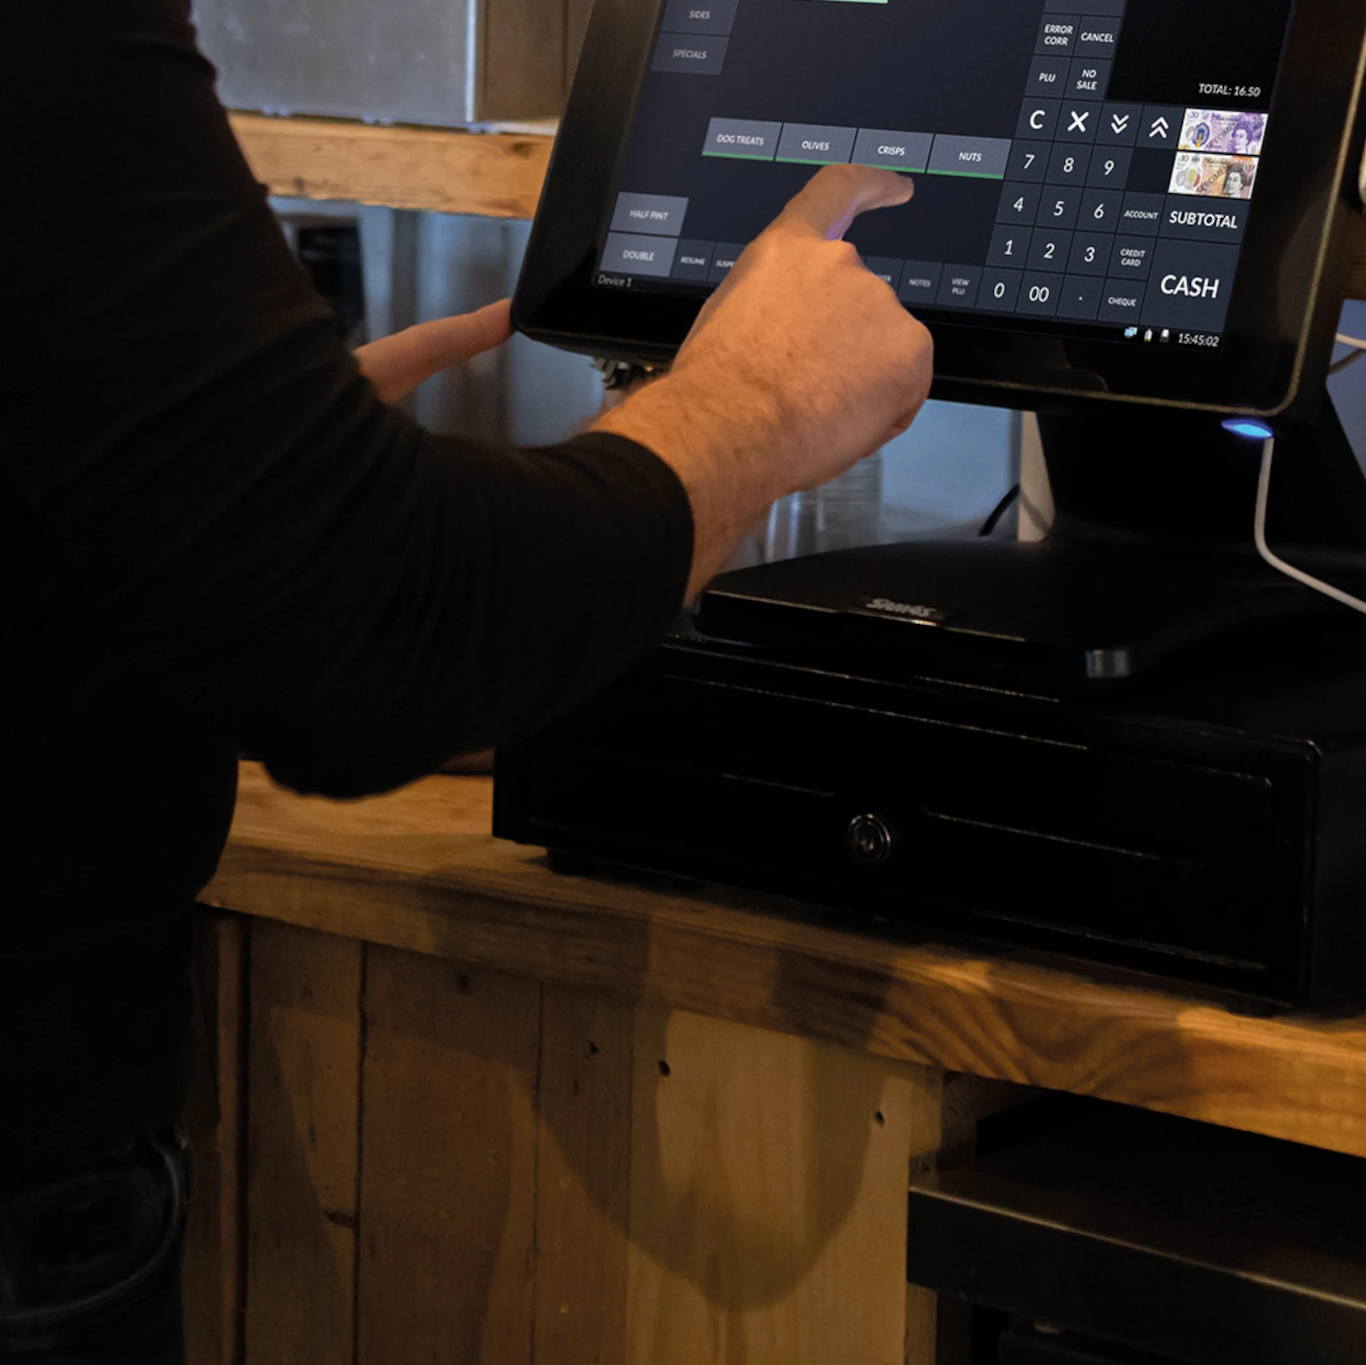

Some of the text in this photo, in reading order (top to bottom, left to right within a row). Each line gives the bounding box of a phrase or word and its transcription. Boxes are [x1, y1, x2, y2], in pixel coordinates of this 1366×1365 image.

[689, 10, 711, 19] SIDES
[1044, 24, 1074, 34] ERROR
[1044, 36, 1069, 46] CORR
[1080, 32, 1114, 43] CANCEL
[672, 48, 708, 60] SPECIALS
[1038, 72, 1056, 82] PLU
[1082, 69, 1097, 78] NO
[1076, 80, 1098, 90] SALE
[1198, 82, 1261, 98] TOTAL: 16.50
[1029, 109, 1046, 129] C
[716, 133, 765, 146] DOG TREATS
[801, 140, 830, 152] OLIVES
[877, 145, 906, 157] CRISPS
[958, 151, 983, 162] NUTS
[1023, 153, 1035, 169] 7
[1063, 157, 1074, 172] 8
[1104, 160, 1115, 175] 9
[1013, 197, 1024, 212] 4
[1053, 200, 1065, 216] 5
[629, 209, 669, 221] HALF PINT
[1093, 203, 1104, 219] 6
[1124, 210, 1158, 220] ACCOUNT
[1169, 210, 1238, 229] SUBTOTAL
[1004, 239, 1013, 255] 1
[1043, 242, 1055, 259] 2
[1120, 248, 1146, 258] CREDIT
[622, 250, 655, 262] DOUBLE
[1084, 246, 1095, 262] 3
[681, 256, 706, 266] RESUME
[1121, 258, 1141, 267] CARD
[598, 275, 625, 287] Device
[909, 278, 931, 288] NOTES
[951, 277, 970, 286] VIEW
[1160, 274, 1220, 299] CASH
[993, 282, 1005, 298] 0
[1029, 286, 1049, 302] 00
[1107, 296, 1137, 307] CHEQUE
[1178, 333, 1220, 347] 15:45:02
